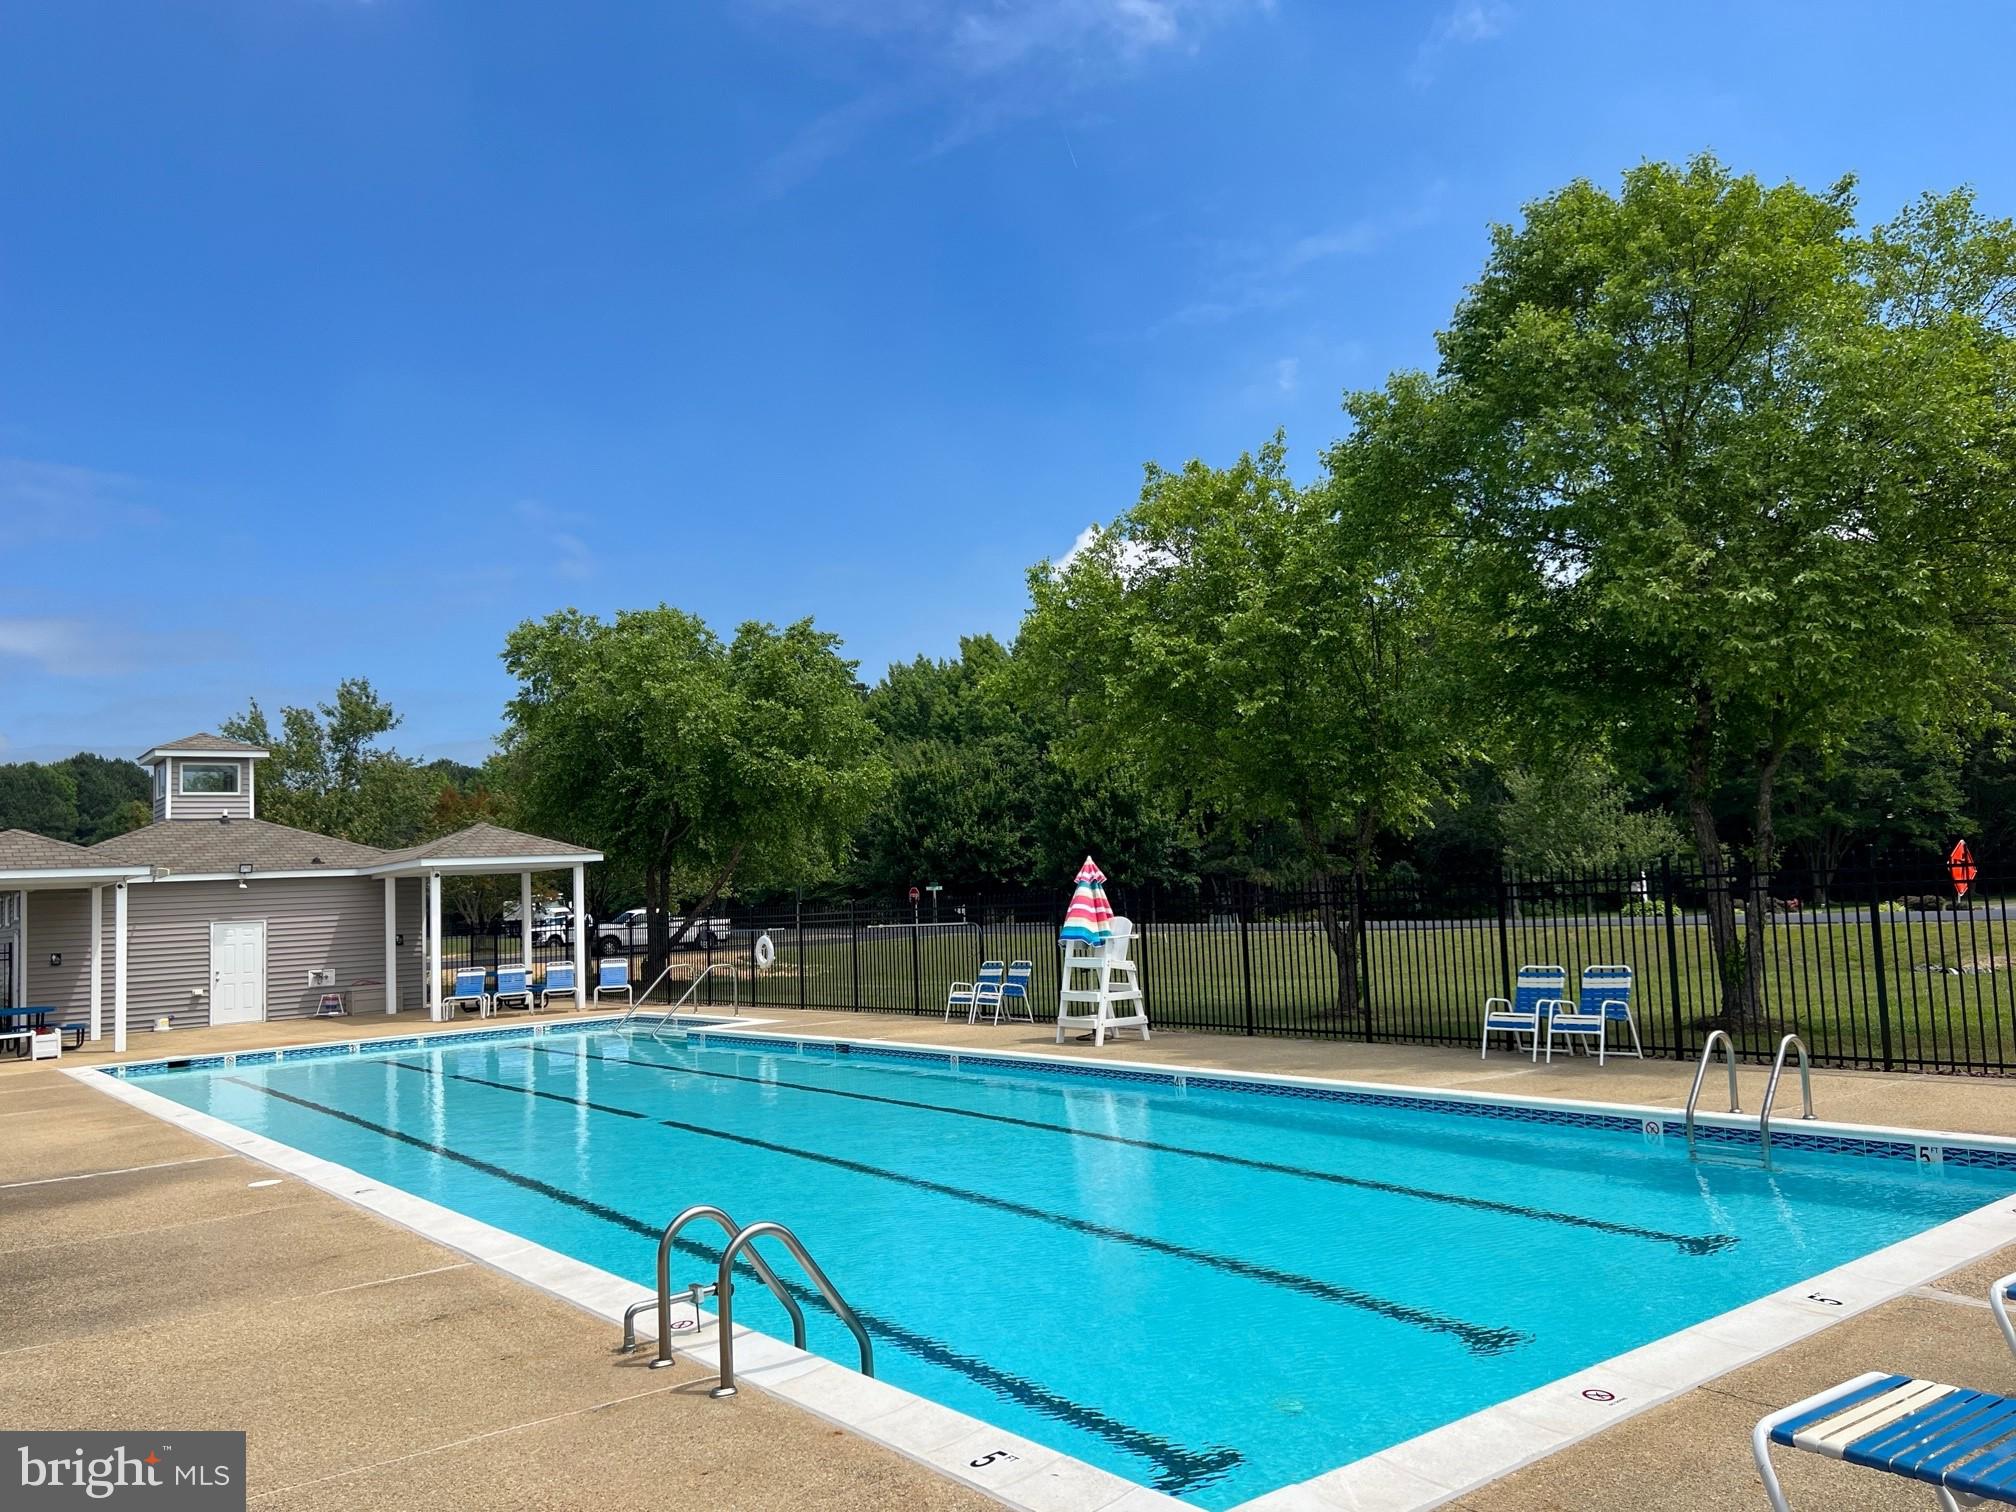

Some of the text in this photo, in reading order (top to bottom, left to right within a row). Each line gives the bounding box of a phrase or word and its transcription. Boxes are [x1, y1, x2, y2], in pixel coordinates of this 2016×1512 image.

[1920, 1146, 1931, 1162] 5
[1807, 1295, 1843, 1306] 5
[970, 1450, 1008, 1468] 5
